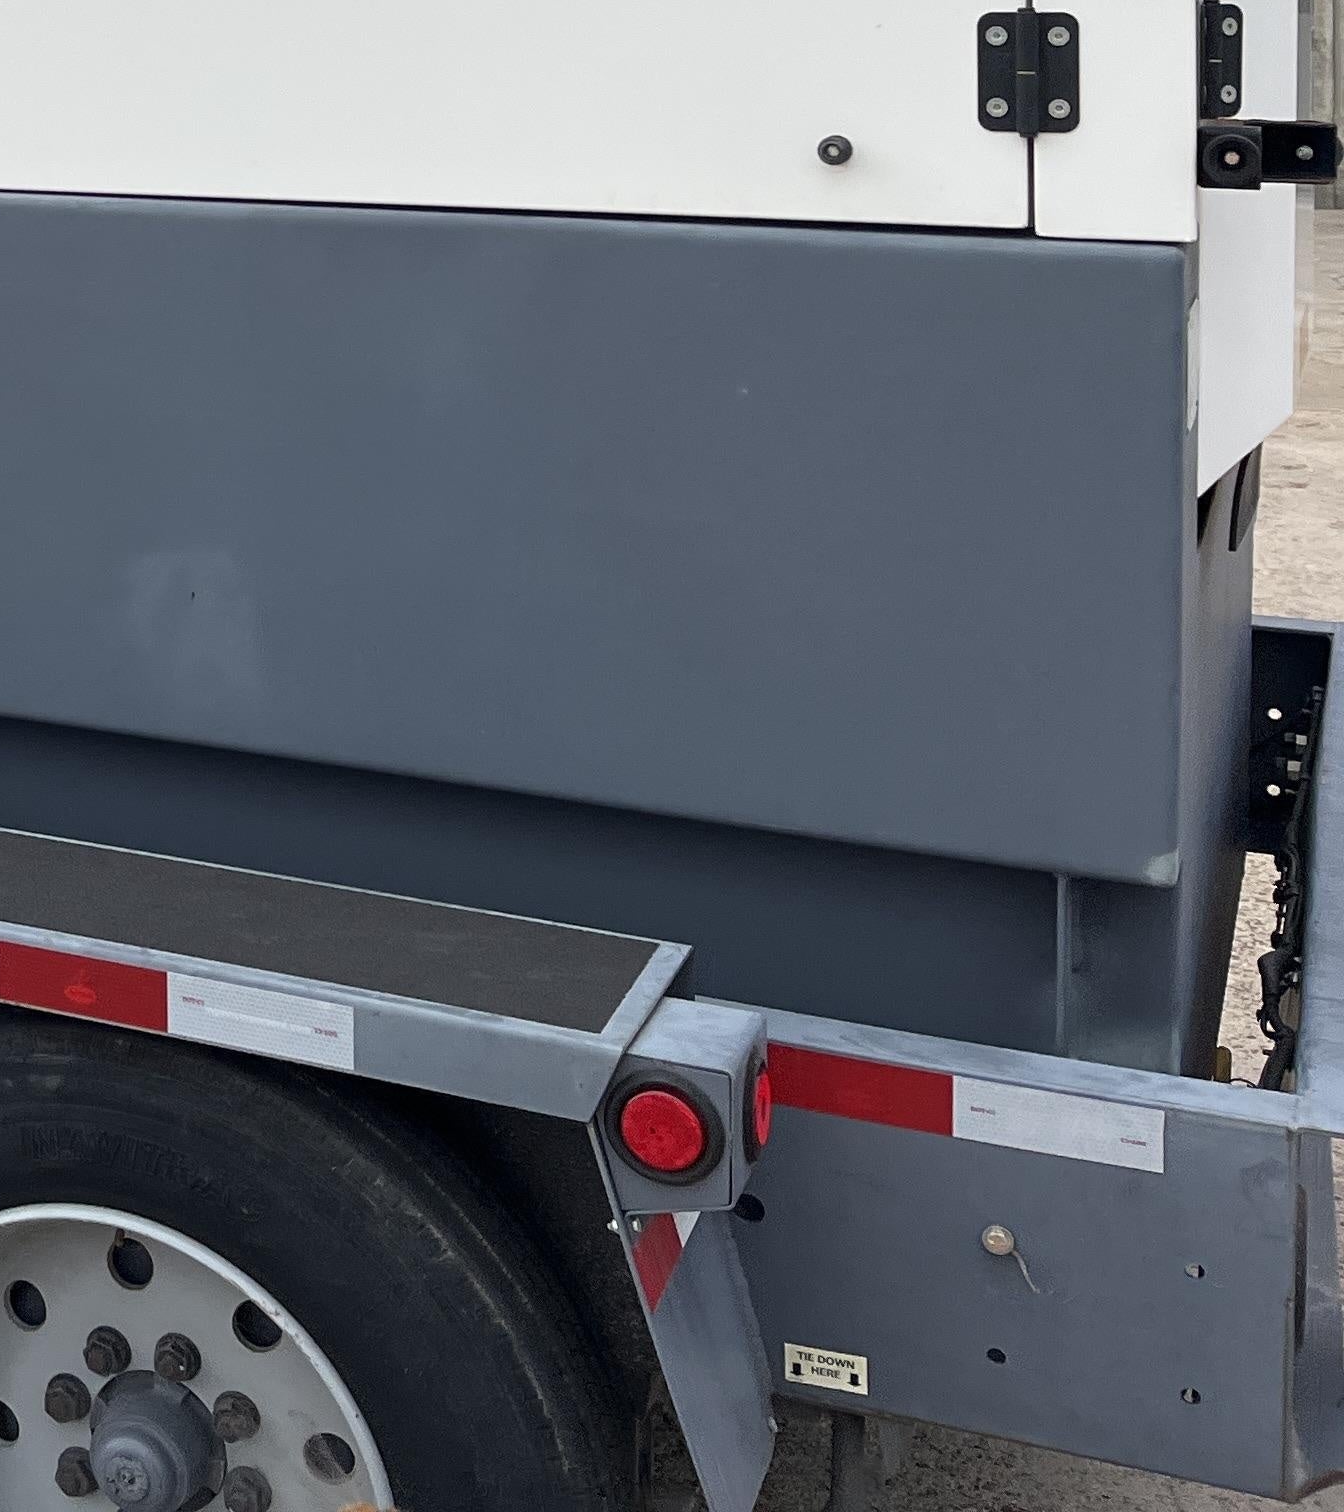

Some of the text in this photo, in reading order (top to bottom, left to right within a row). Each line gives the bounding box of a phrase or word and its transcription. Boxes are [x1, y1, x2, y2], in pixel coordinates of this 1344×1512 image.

[796, 1351, 855, 1369] TIE DOWN
[811, 1366, 842, 1379] HERE
